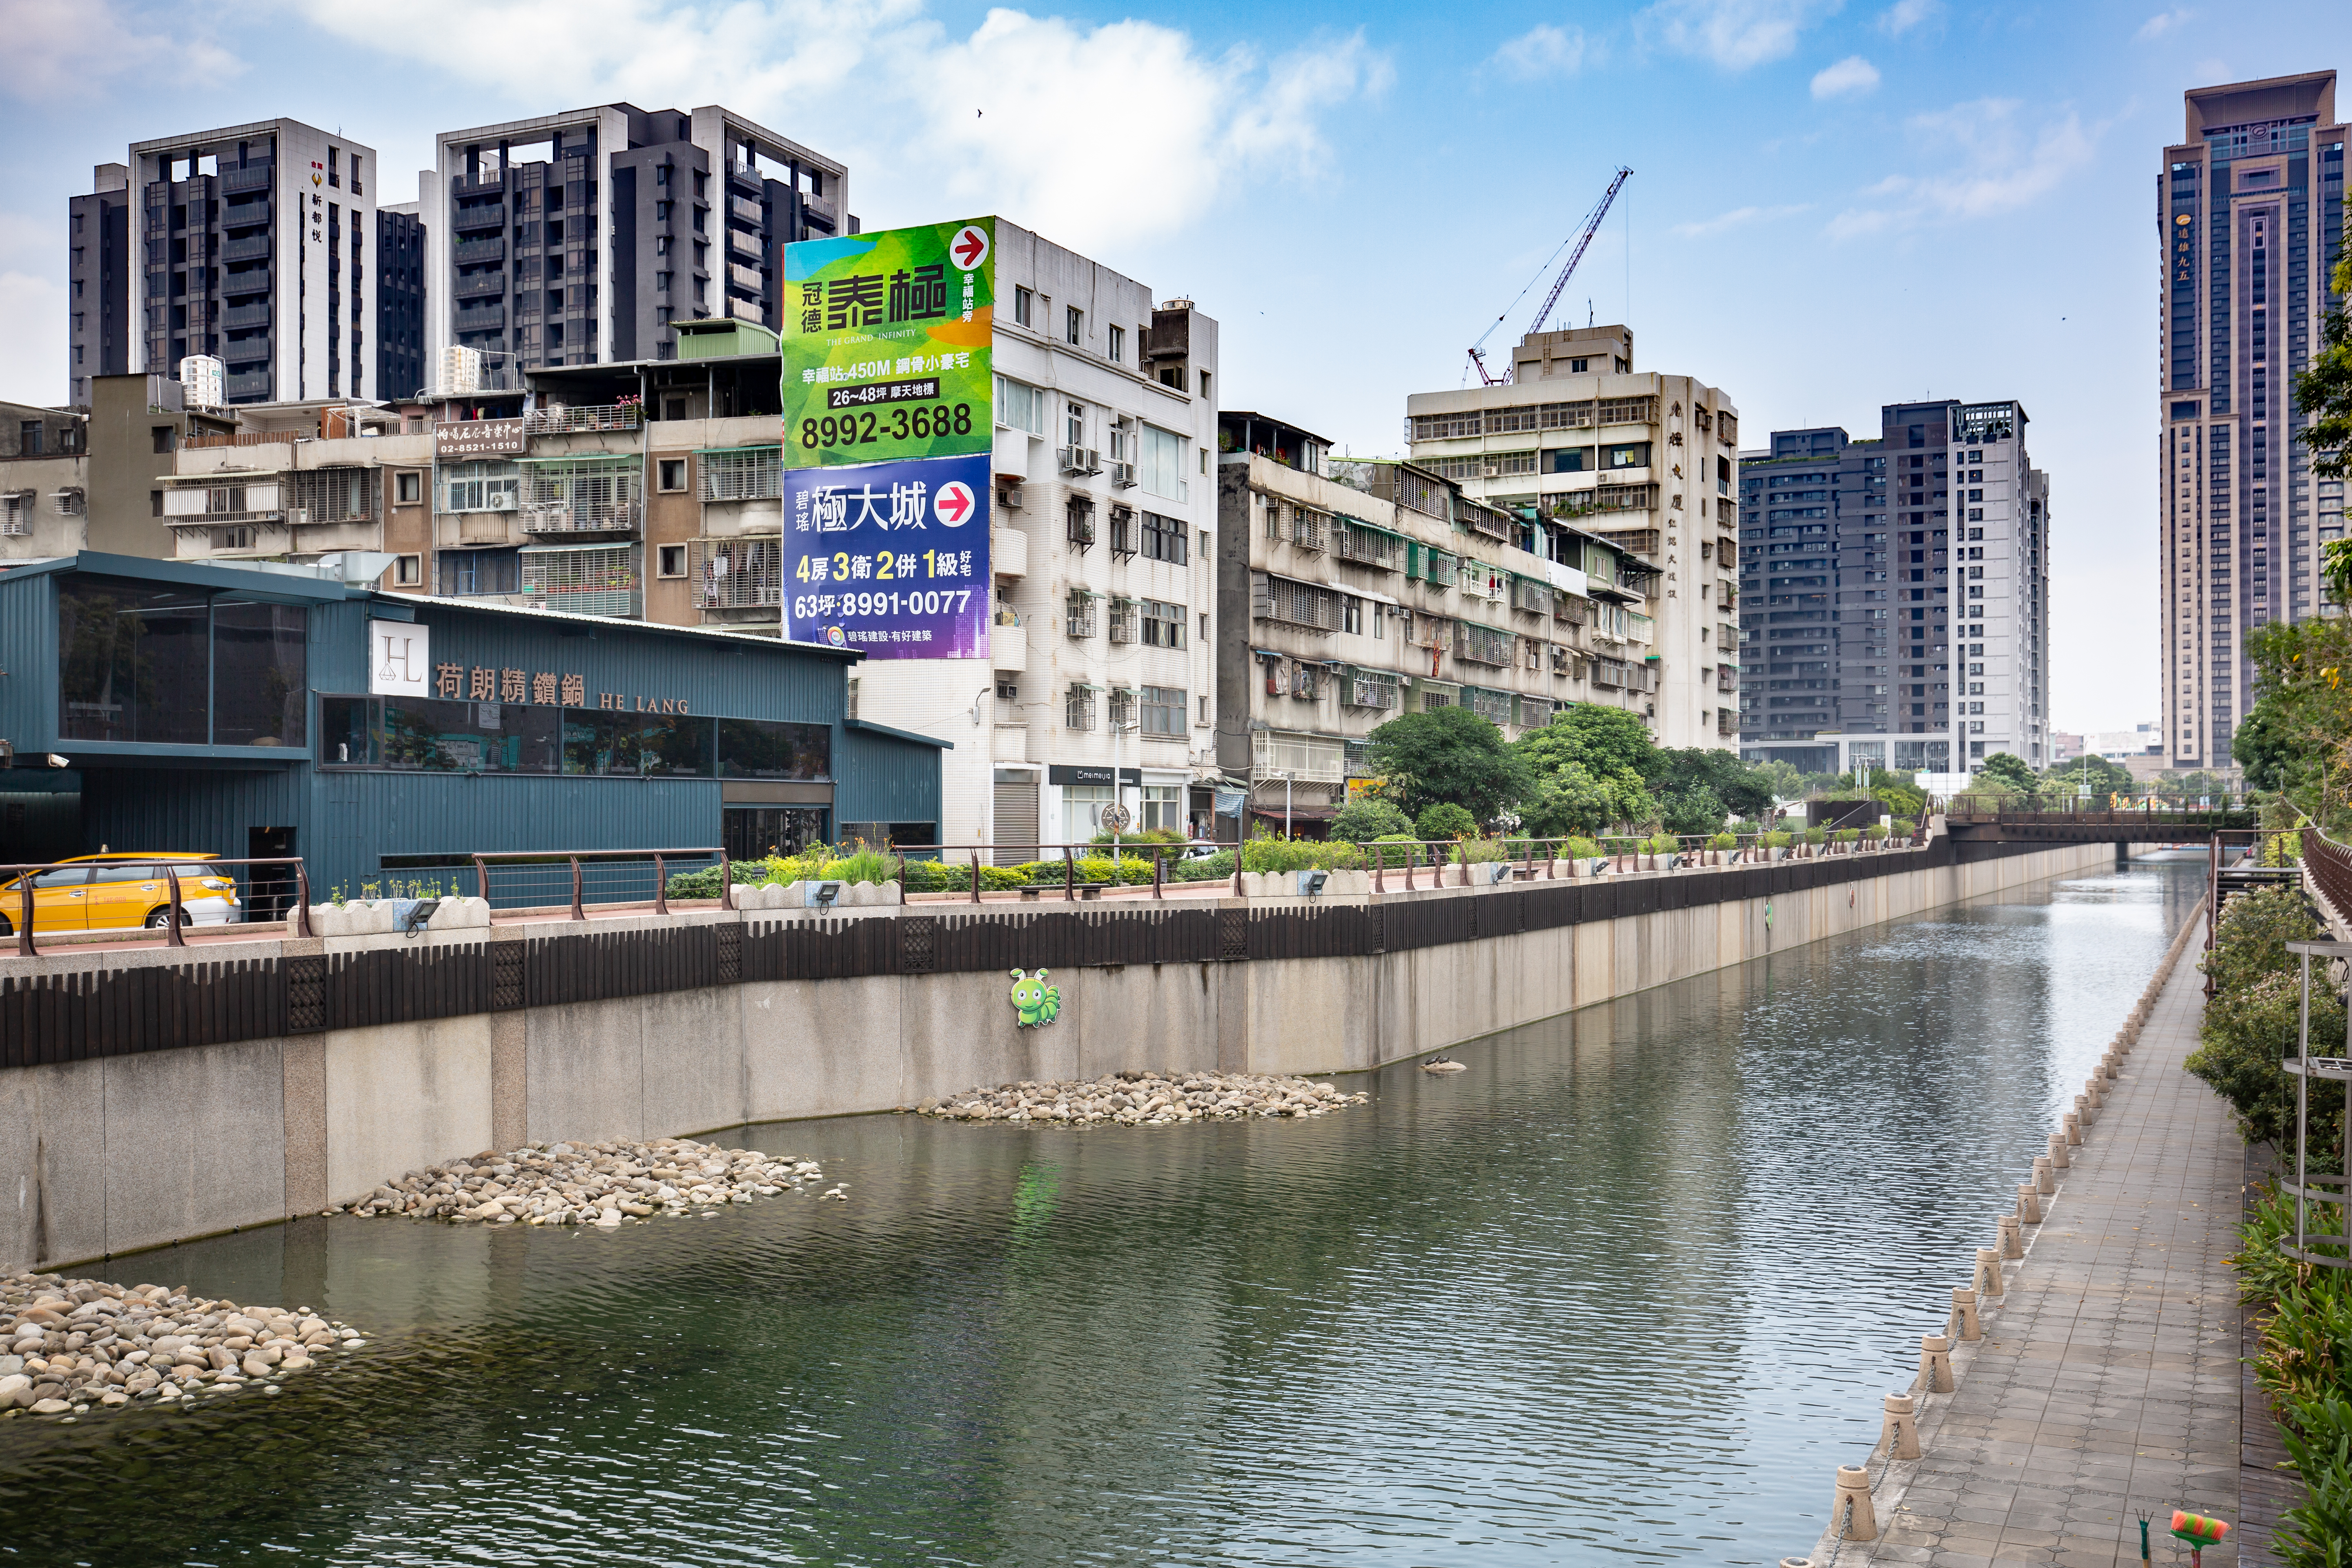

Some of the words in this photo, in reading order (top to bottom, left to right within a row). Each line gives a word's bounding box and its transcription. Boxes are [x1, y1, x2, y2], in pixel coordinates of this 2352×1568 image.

[801, 281, 822, 334] 冠德
[962, 273, 974, 323] 幸福站旁
[826, 338, 842, 347] THE
[844, 334, 873, 345] GRAND
[879, 329, 916, 340] INFINITY
[896, 352, 969, 375] 鋼骨小豪宅
[891, 382, 934, 399] 摩天地標
[441, 441, 517, 452] 02-8521-1510
[802, 403, 972, 449] 8992-3688
[796, 490, 809, 532] 碧瑤
[811, 481, 927, 532] 極大城
[435, 662, 584, 707] 荷朗精鑽鍋
[599, 693, 624, 710] HE
[636, 695, 688, 715] LANG
